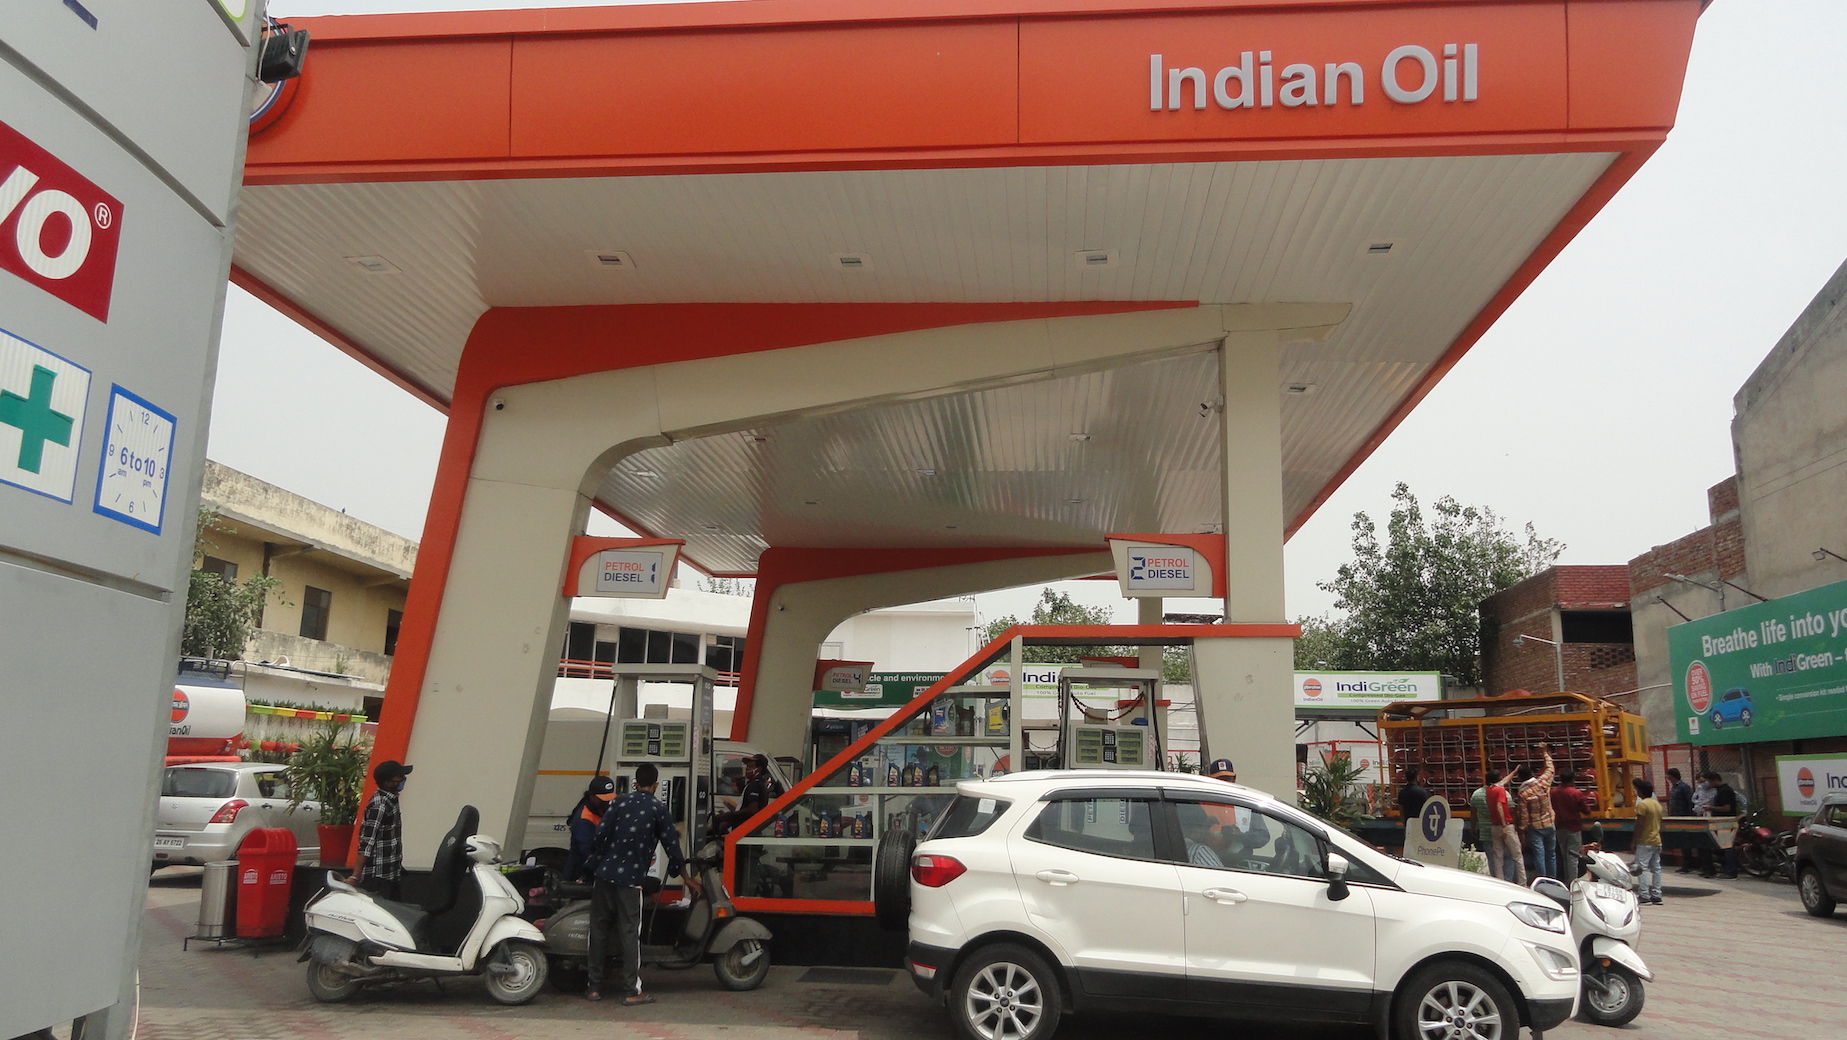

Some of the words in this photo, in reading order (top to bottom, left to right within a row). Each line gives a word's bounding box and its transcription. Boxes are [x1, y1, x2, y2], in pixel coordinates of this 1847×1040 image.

[1150, 50, 1364, 111] Indian
[1381, 43, 1478, 104] Oil
[141, 411, 151, 425] 12
[109, 443, 115, 456] 9
[120, 447, 128, 466] 6
[144, 457, 156, 478] 10
[117, 468, 127, 477] am
[160, 467, 165, 479] 3
[142, 479, 152, 488] pm
[128, 501, 134, 513] 6
[605, 561, 644, 572] PETROL
[1130, 556, 1146, 580] 2
[1147, 558, 1189, 568] PETROL
[604, 572, 643, 582] DIESEL
[1147, 569, 1190, 579] DIESEL
[1701, 626, 1759, 657] Breathe
[1760, 618, 1787, 645] life
[1790, 611, 1826, 639] into
[1750, 661, 1773, 678] With
[884, 673, 899, 681] and
[1336, 681, 1418, 692] IndiGreen
[1417, 845, 1445, 857] PhonePe
